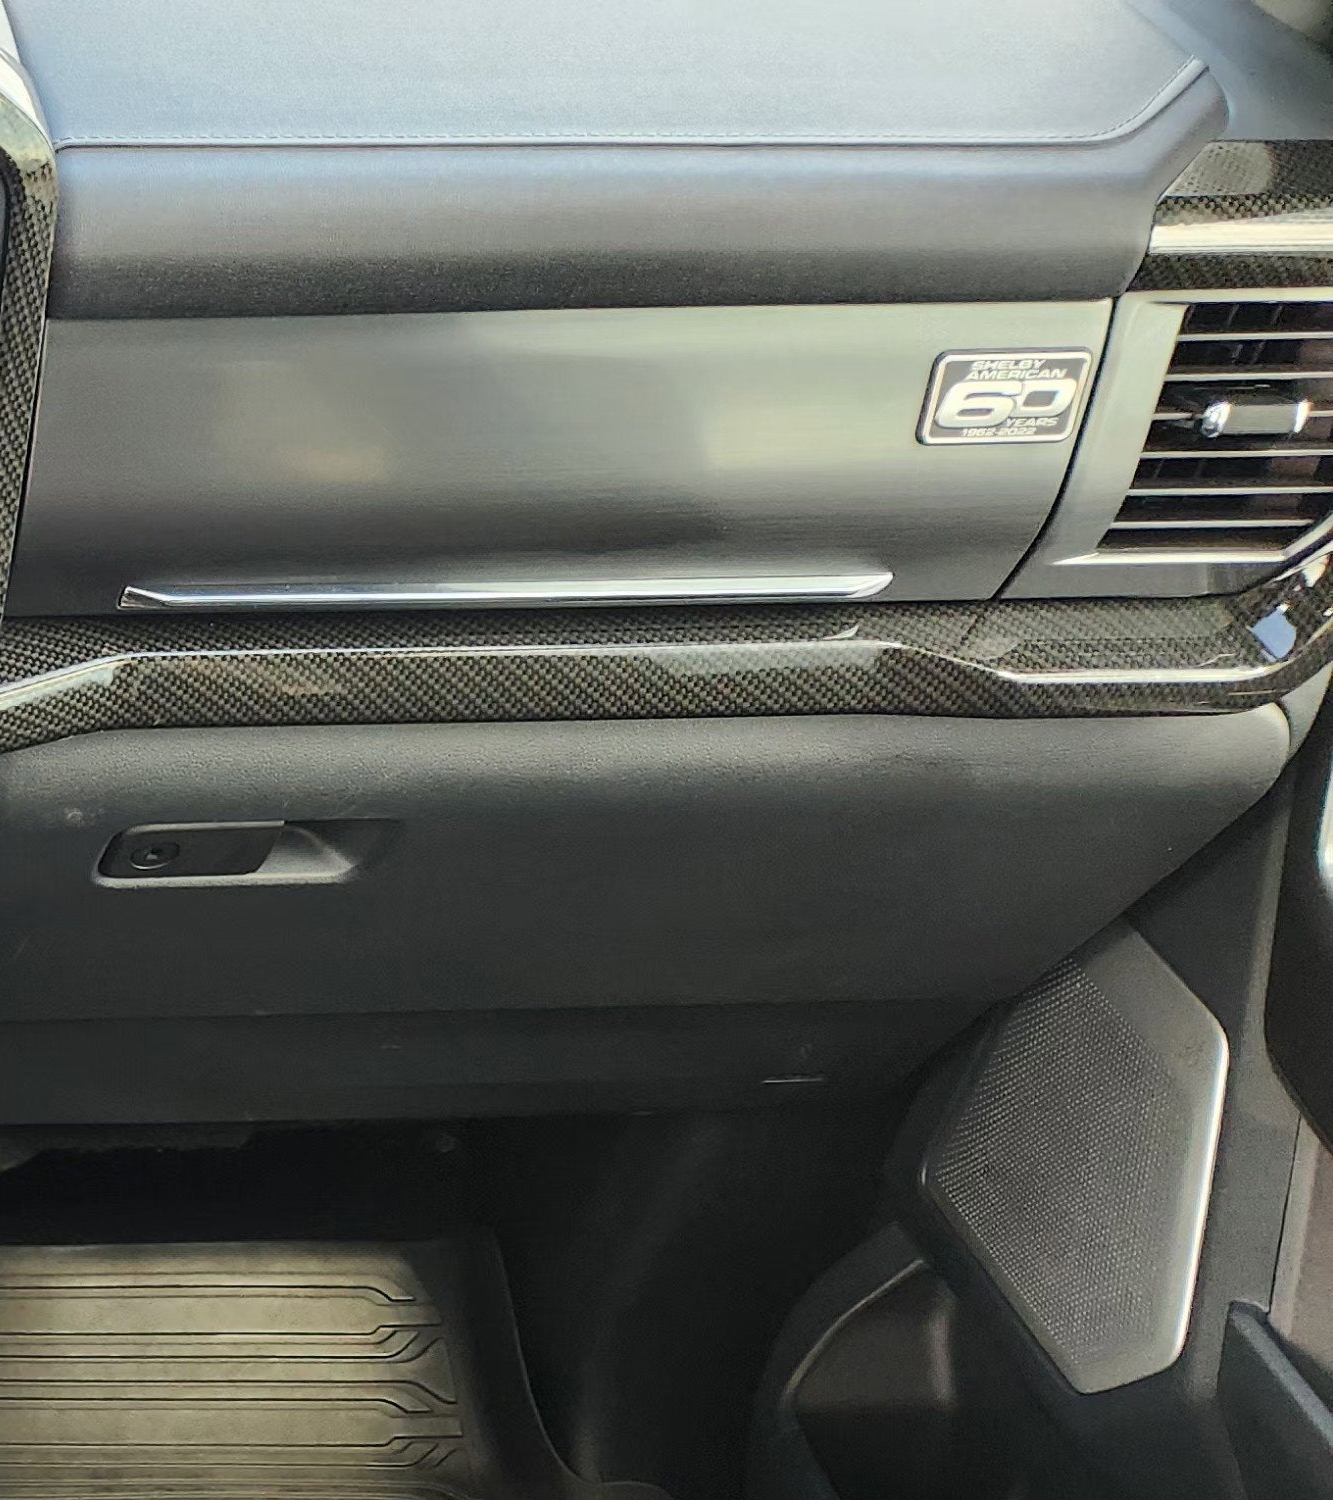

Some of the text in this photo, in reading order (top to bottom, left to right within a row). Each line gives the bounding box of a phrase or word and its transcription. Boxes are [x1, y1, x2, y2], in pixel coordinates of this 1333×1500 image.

[971, 359, 1047, 372] SHELBY
[965, 368, 1069, 380] AMERICAN
[934, 378, 1079, 429] 60
[1006, 417, 1059, 428] YEARS
[961, 427, 1037, 437] 1962-2022
